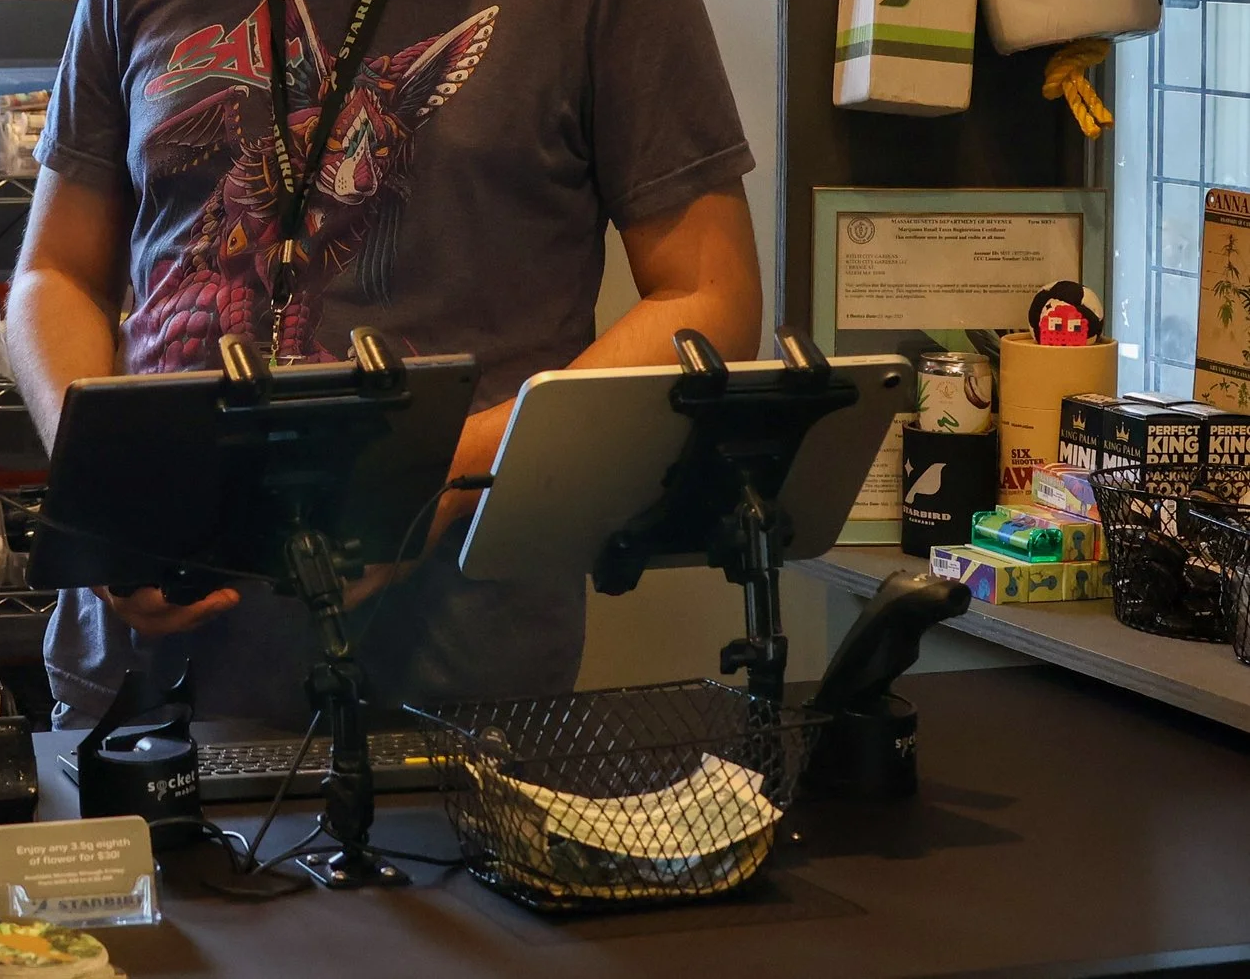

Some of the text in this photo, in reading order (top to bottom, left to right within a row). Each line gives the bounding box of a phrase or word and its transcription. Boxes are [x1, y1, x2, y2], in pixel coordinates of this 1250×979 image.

[1060, 429, 1097, 446] KING PALM
[1148, 425, 1199, 435] PERFECT
[1011, 448, 1032, 459] SIX
[1103, 440, 1141, 458] KING PALM
[1147, 436, 1199, 454] KING
[1209, 436, 1250, 454] KIN
[1059, 441, 1097, 471] MINI
[16, 844, 46, 856] Enjoy
[48, 843, 68, 853] any
[96, 837, 131, 850] eighth
[29, 856, 41, 866] of
[43, 853, 76, 865] flower
[79, 851, 94, 861] for
